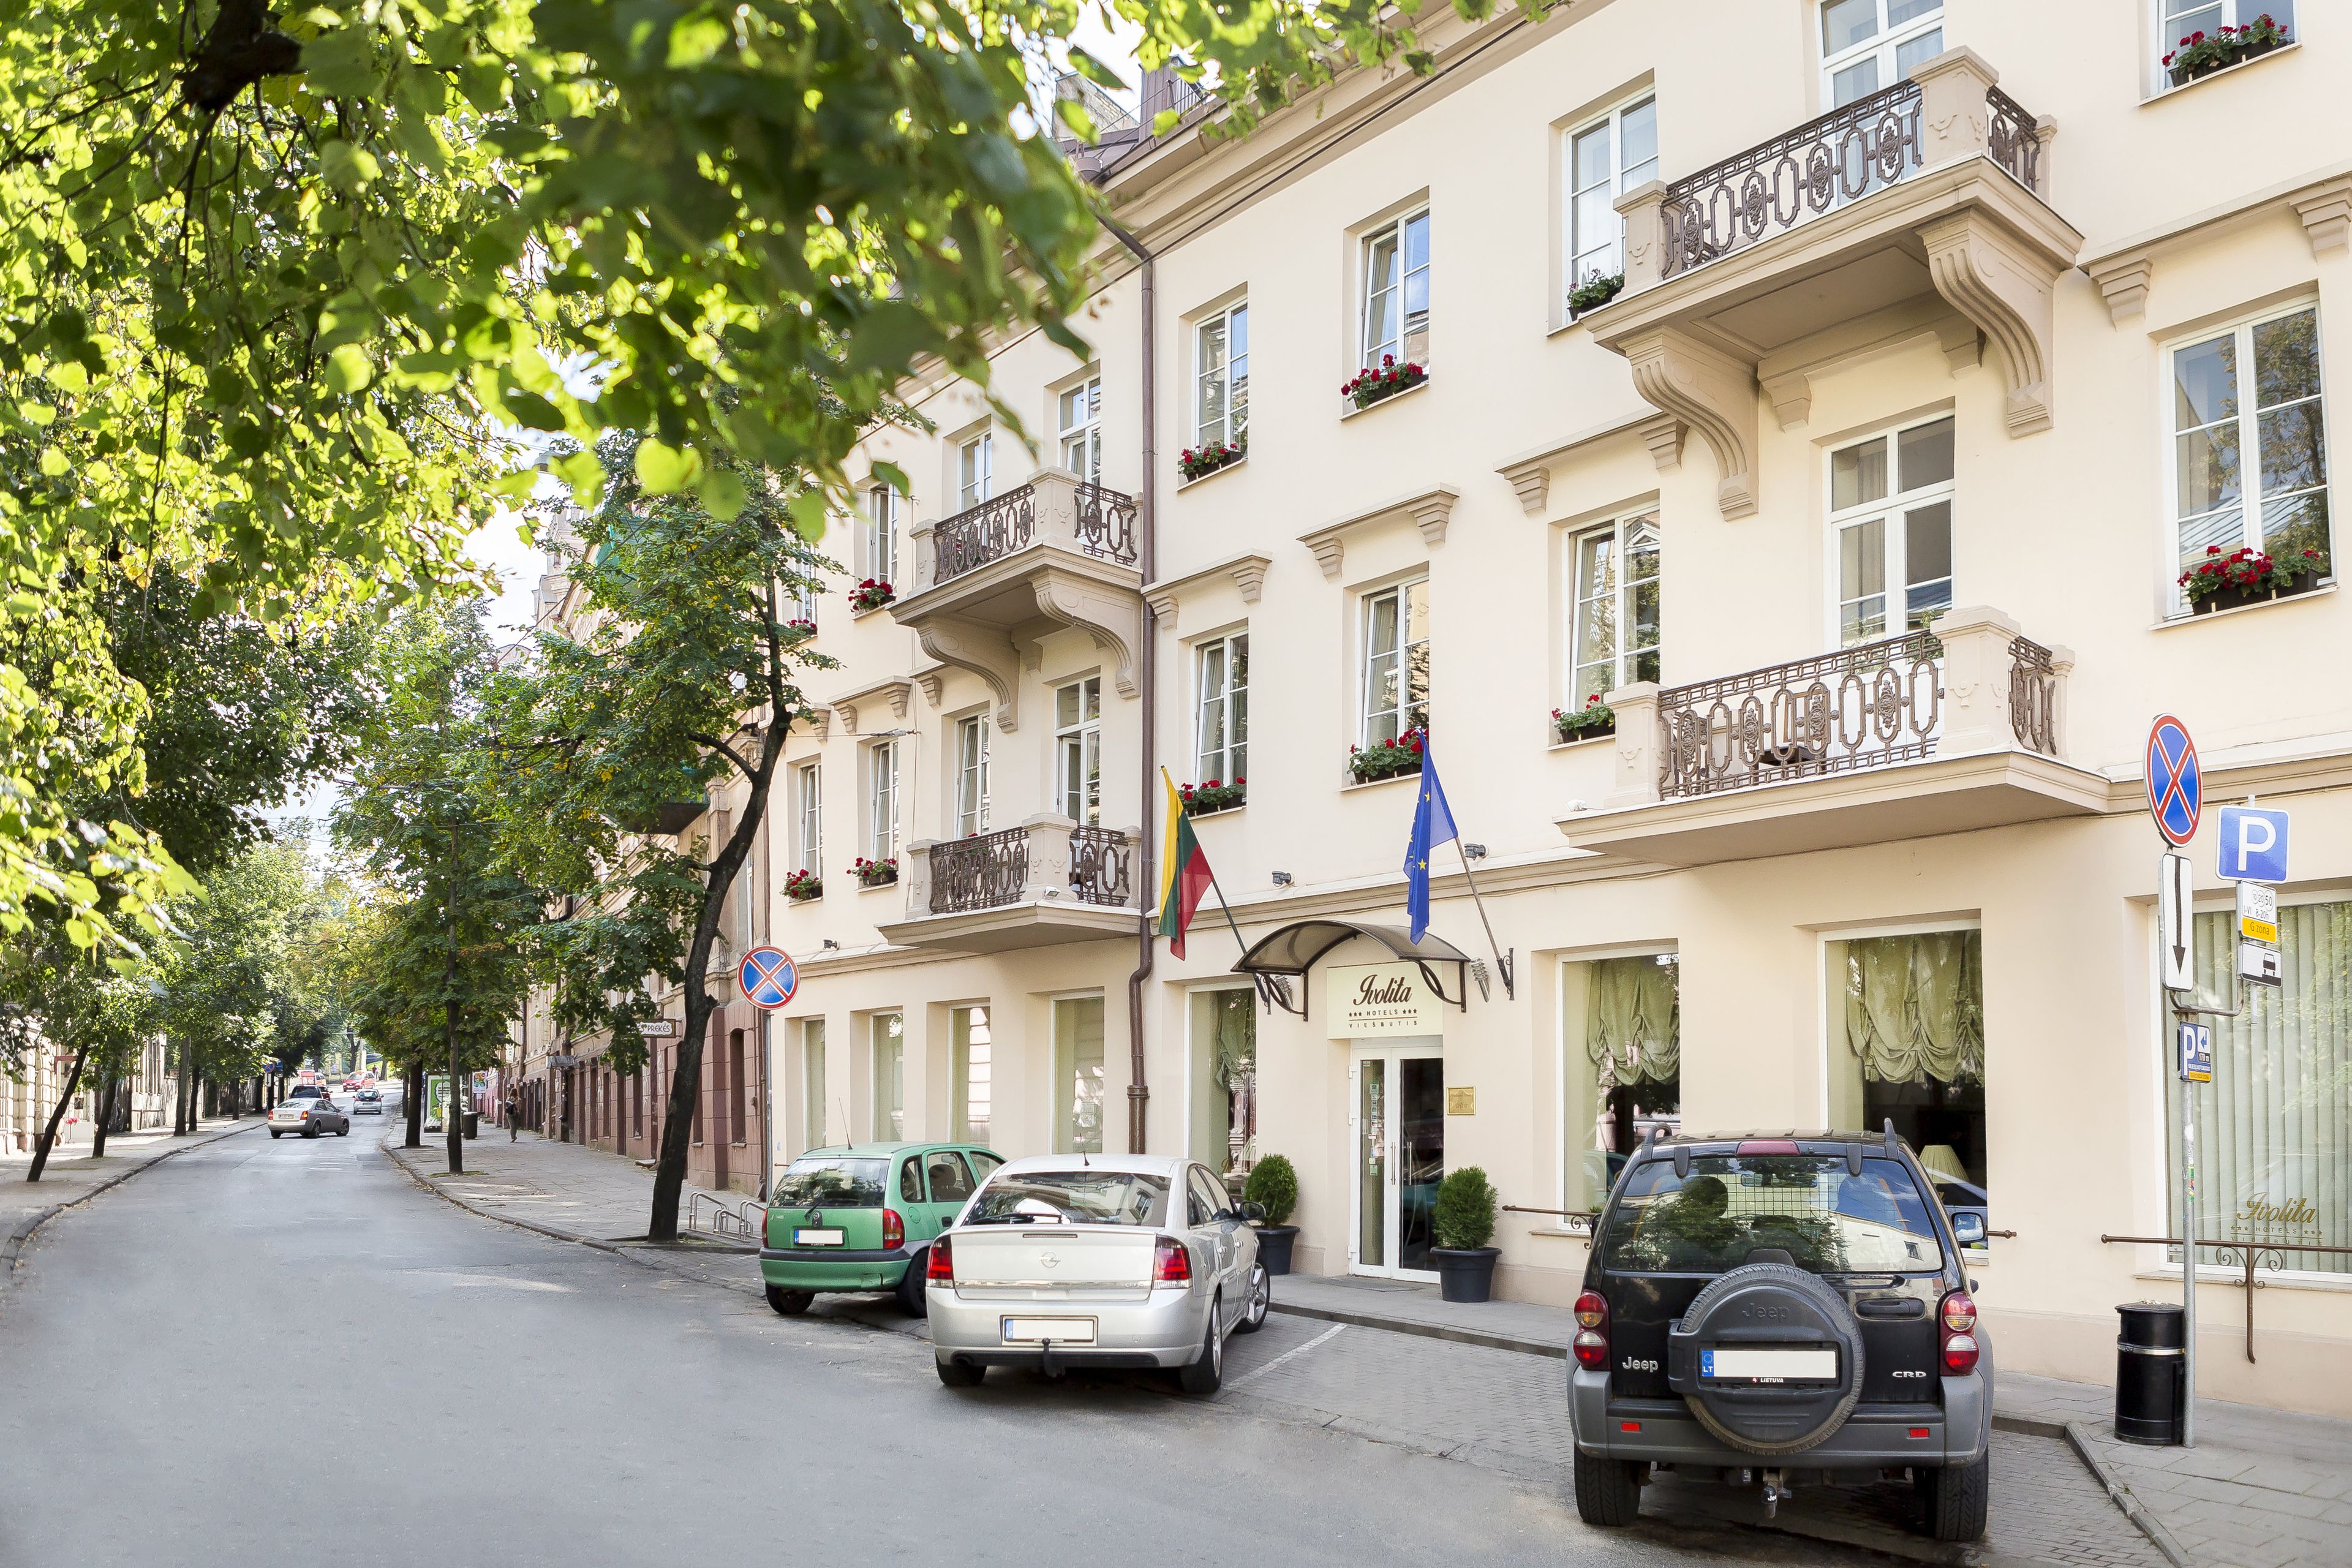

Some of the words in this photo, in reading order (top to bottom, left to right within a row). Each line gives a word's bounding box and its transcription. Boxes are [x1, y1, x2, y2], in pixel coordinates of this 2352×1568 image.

[2237, 815, 2277, 872] P
[2265, 895, 2272, 907] 50
[2250, 921, 2255, 932] G
[2256, 925, 2269, 935] zona
[1352, 974, 1412, 1006] Ivolita
[647, 1023, 670, 1032] PREKĖS
[2184, 1026, 2196, 1076] P
[2236, 1192, 2317, 1224] Ivolita
[1741, 1303, 1789, 1322] Jeep
[1622, 1356, 1658, 1373] Jeep
